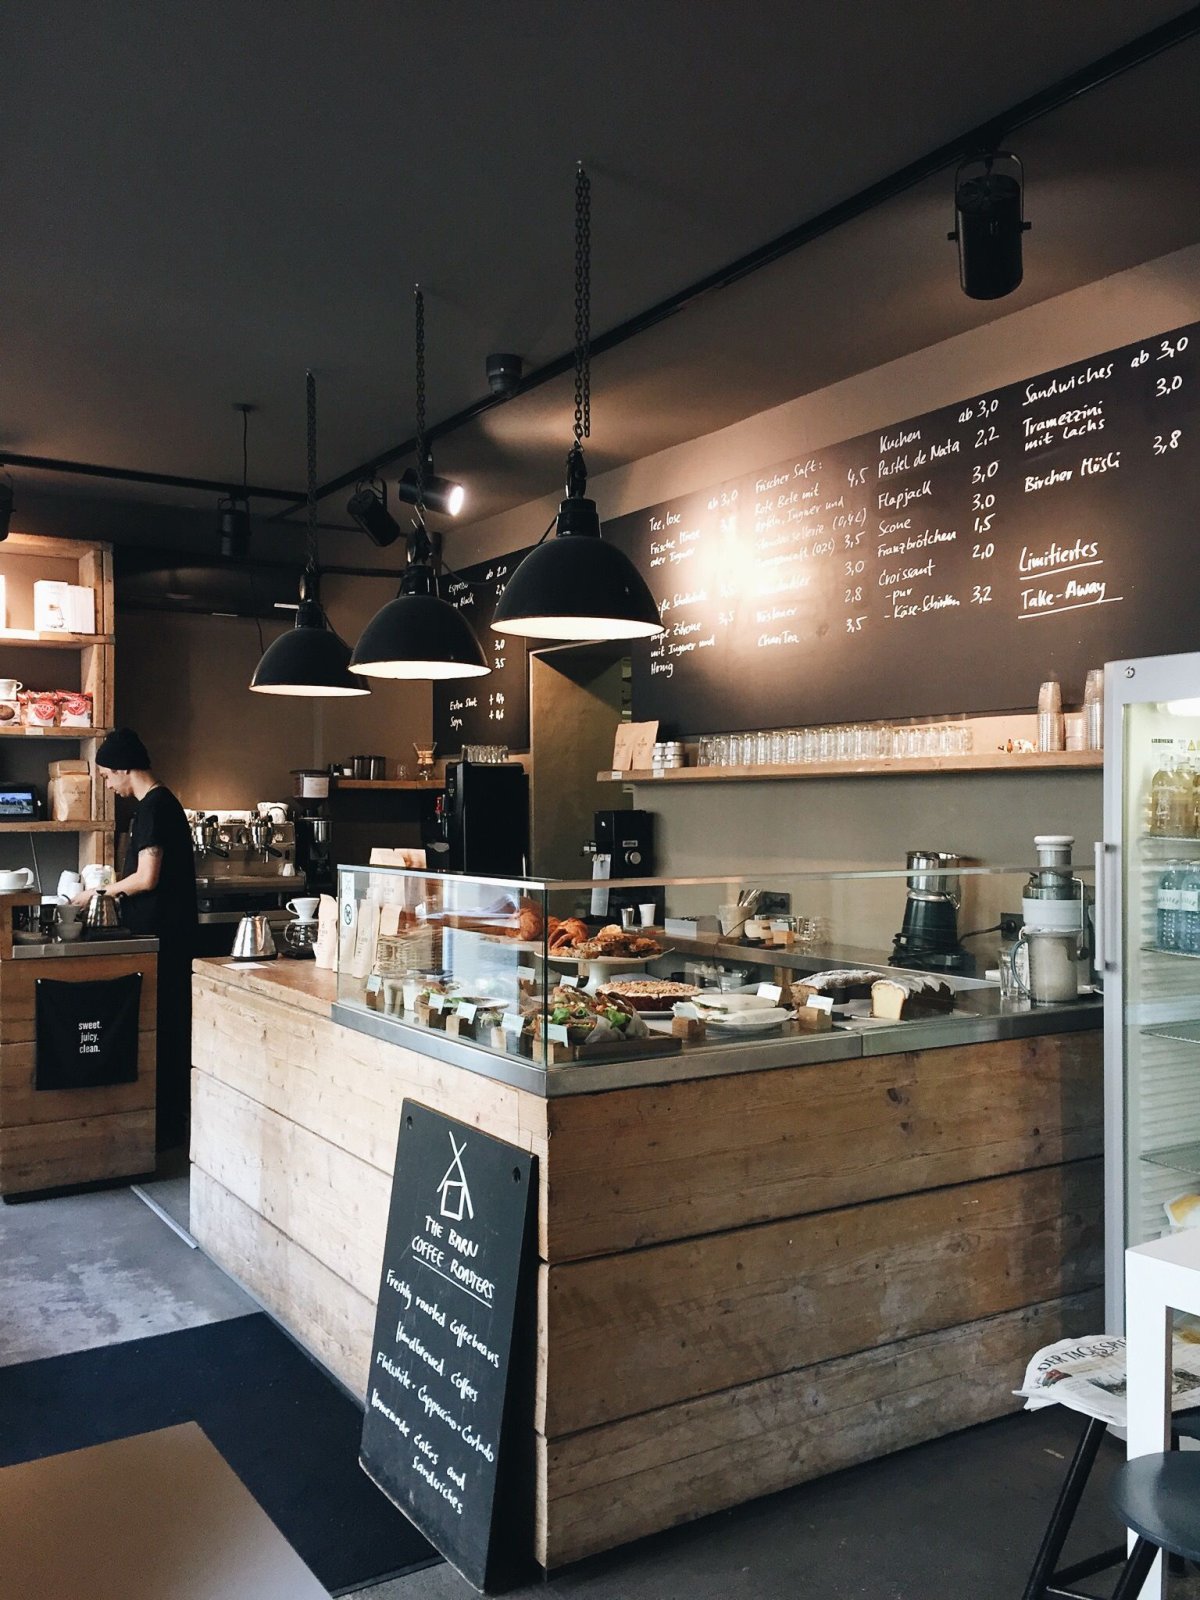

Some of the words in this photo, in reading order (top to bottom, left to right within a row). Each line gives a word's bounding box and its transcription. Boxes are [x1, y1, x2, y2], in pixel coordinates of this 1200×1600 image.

[1022, 363, 1114, 406] Sandwiches
[1131, 349, 1150, 369] ab
[1156, 335, 1189, 361] 3,0
[1022, 400, 1104, 437] Tramezzini
[1155, 375, 1184, 397] 3,0
[879, 430, 922, 454] Kuchen
[958, 407, 973, 423] ab
[976, 399, 999, 419] 3,0
[878, 455, 910, 479] Pastel
[913, 449, 927, 466] de
[929, 440, 961, 461] Nata
[974, 426, 1000, 449] 2,2
[1024, 433, 1054, 452] mit
[1024, 469, 1073, 493] Bircher
[1080, 451, 1121, 477] Müsli
[1152, 429, 1182, 455] 3,8
[755, 473, 790, 494] Frischer
[793, 460, 824, 479] Saft:
[847, 466, 869, 488] 4,5
[878, 480, 933, 510] Flapjack
[971, 460, 1000, 484] 3,0
[666, 512, 681, 526] lose
[720, 489, 738, 507] 3,0
[777, 491, 799, 510] Bete
[802, 482, 820, 500] mit
[787, 504, 822, 524] Ingwer
[825, 495, 845, 512] und
[844, 530, 866, 549] 3,5
[877, 530, 957, 558] Franzbrötchen
[974, 513, 996, 534] 1,5
[878, 518, 912, 537] Scone
[649, 556, 666, 568] oder
[669, 547, 695, 565] Ingwer
[650, 539, 676, 555] Frische
[1019, 538, 1099, 572] Limitiertes
[844, 560, 865, 576] 3,0
[878, 558, 936, 586] Croissant
[972, 542, 995, 560] 2,0
[844, 586, 863, 603] 2,8
[970, 585, 993, 604] 3,2
[1020, 579, 1107, 611] Take-Away
[673, 620, 702, 636] Zitrone
[845, 615, 868, 633] 3,5
[650, 645, 665, 658] mit
[668, 641, 696, 657] Ingwer
[698, 634, 715, 648] und
[650, 660, 674, 679] Honig
[78, 1020, 102, 1030] sweet.
[80, 1032, 99, 1044] juicy.
[79, 1044, 101, 1054] clean.
[425, 1215, 444, 1238] THE
[448, 1228, 479, 1258] BARN
[411, 1235, 445, 1267] COFFEE
[450, 1258, 495, 1299] ROASTERS
[386, 1268, 412, 1310] Freshly
[415, 1296, 446, 1328] roasted
[396, 1324, 445, 1376] Handbrewed
[1037, 1354, 1068, 1371] DER
[371, 1388, 411, 1438] Homemade
[446, 1466, 467, 1491] and
[461, 1425, 494, 1463] Cortado
